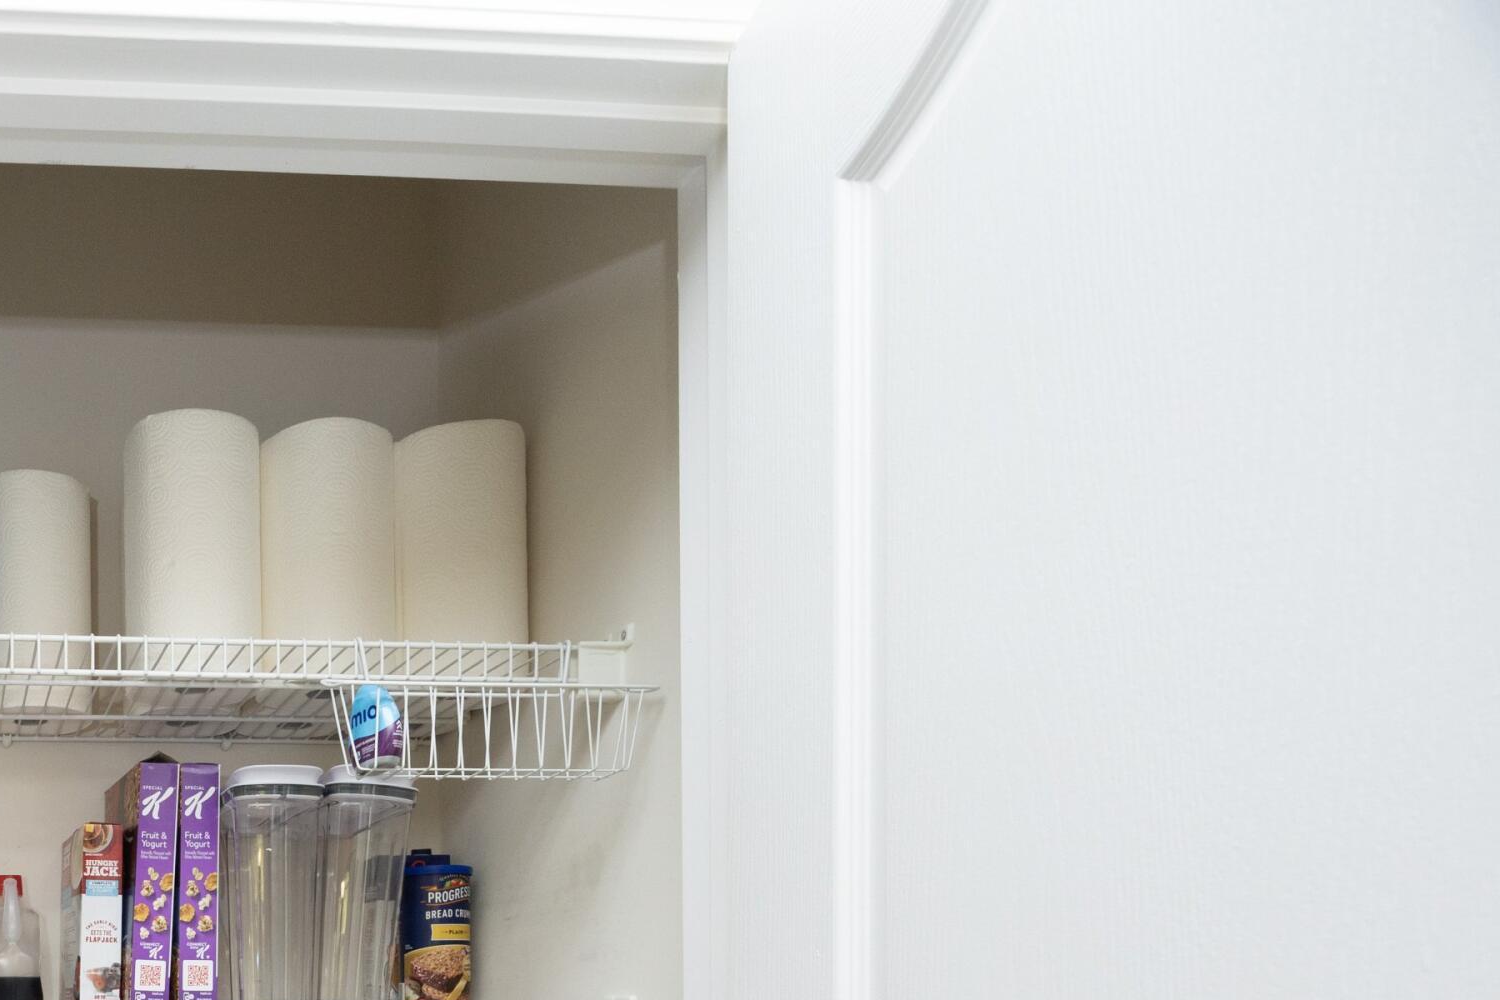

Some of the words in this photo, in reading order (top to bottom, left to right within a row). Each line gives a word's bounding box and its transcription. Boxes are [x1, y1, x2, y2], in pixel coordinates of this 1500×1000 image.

[351, 704, 378, 729] mio
[142, 786, 174, 820] K
[184, 786, 216, 820] K
[141, 830, 160, 840] Fruit
[161, 831, 168, 840] &
[184, 830, 203, 840] Fruit
[204, 831, 211, 840] &
[141, 839, 168, 850] Yogurt
[184, 839, 211, 850] Yogurt
[85, 859, 119, 867] HUNGRY
[83, 866, 119, 877] JACK
[425, 908, 453, 920] BREAD
